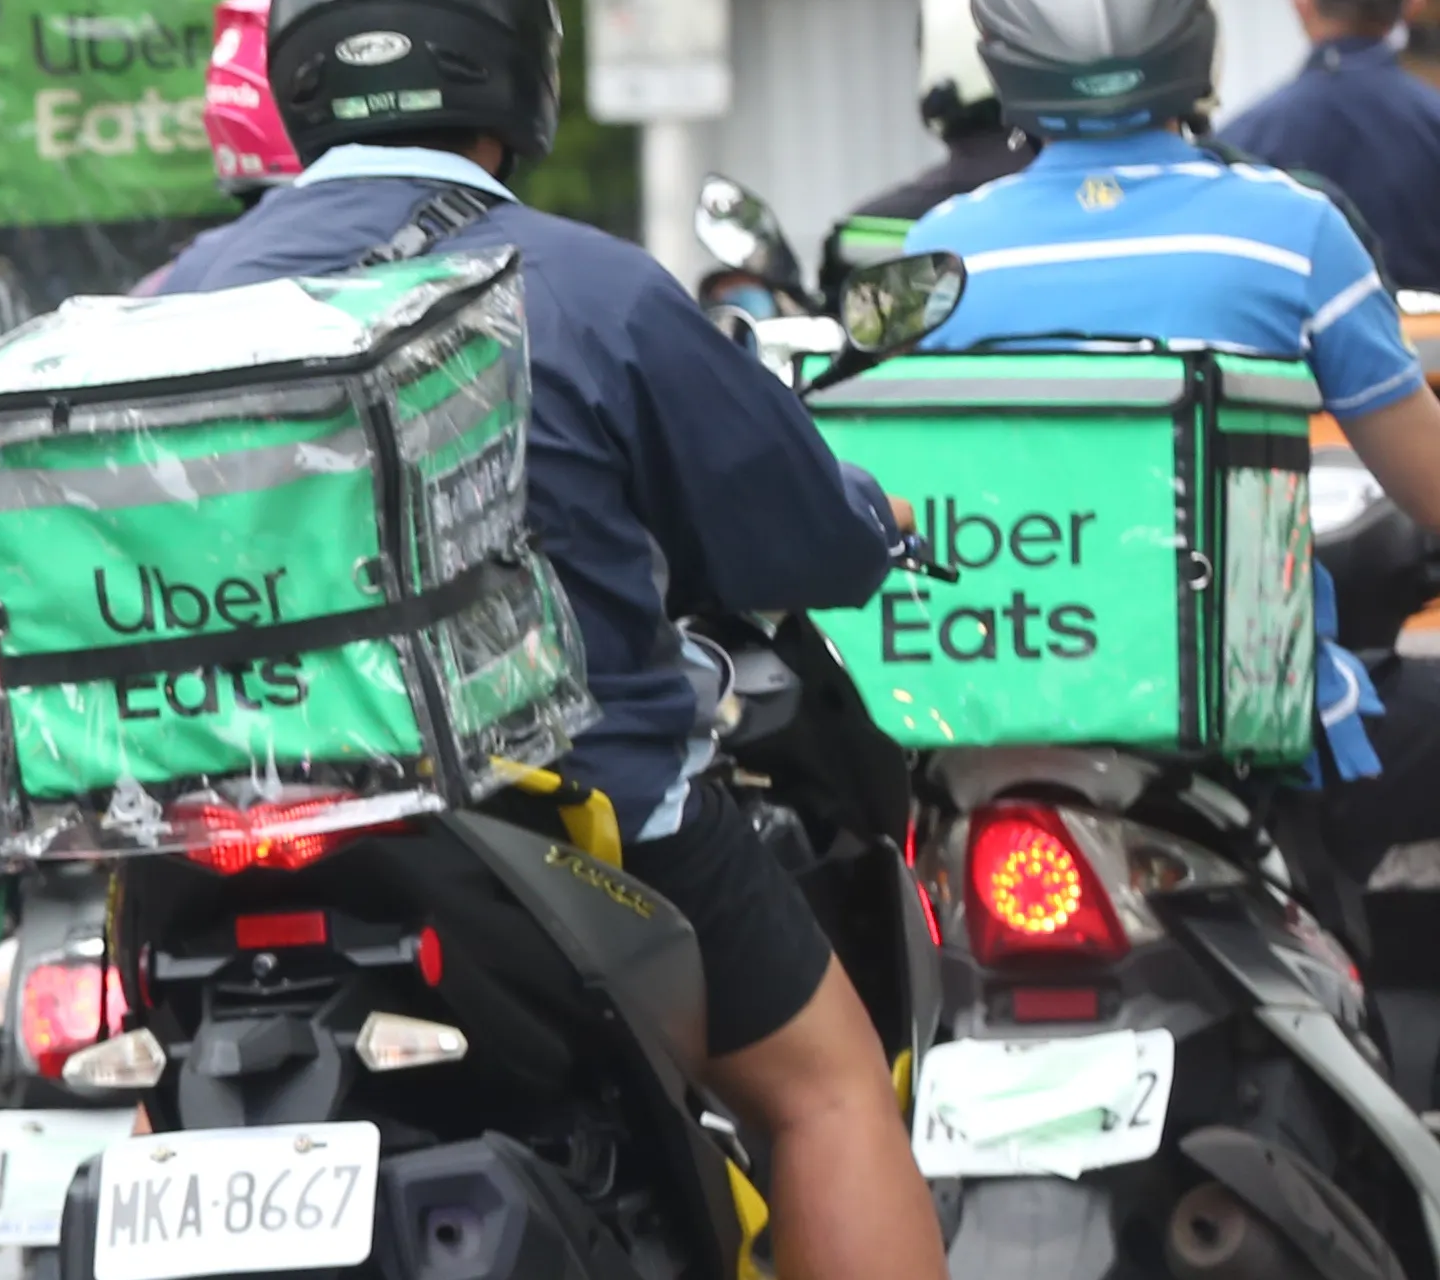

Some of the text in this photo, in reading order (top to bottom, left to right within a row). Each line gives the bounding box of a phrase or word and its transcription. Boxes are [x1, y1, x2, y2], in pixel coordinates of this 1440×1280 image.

[33, 9, 209, 78] Uber
[36, 86, 211, 160] Eats
[93, 564, 288, 635] Uber
[881, 589, 1099, 664] Eats
[110, 1165, 362, 1247] MKA-8667
